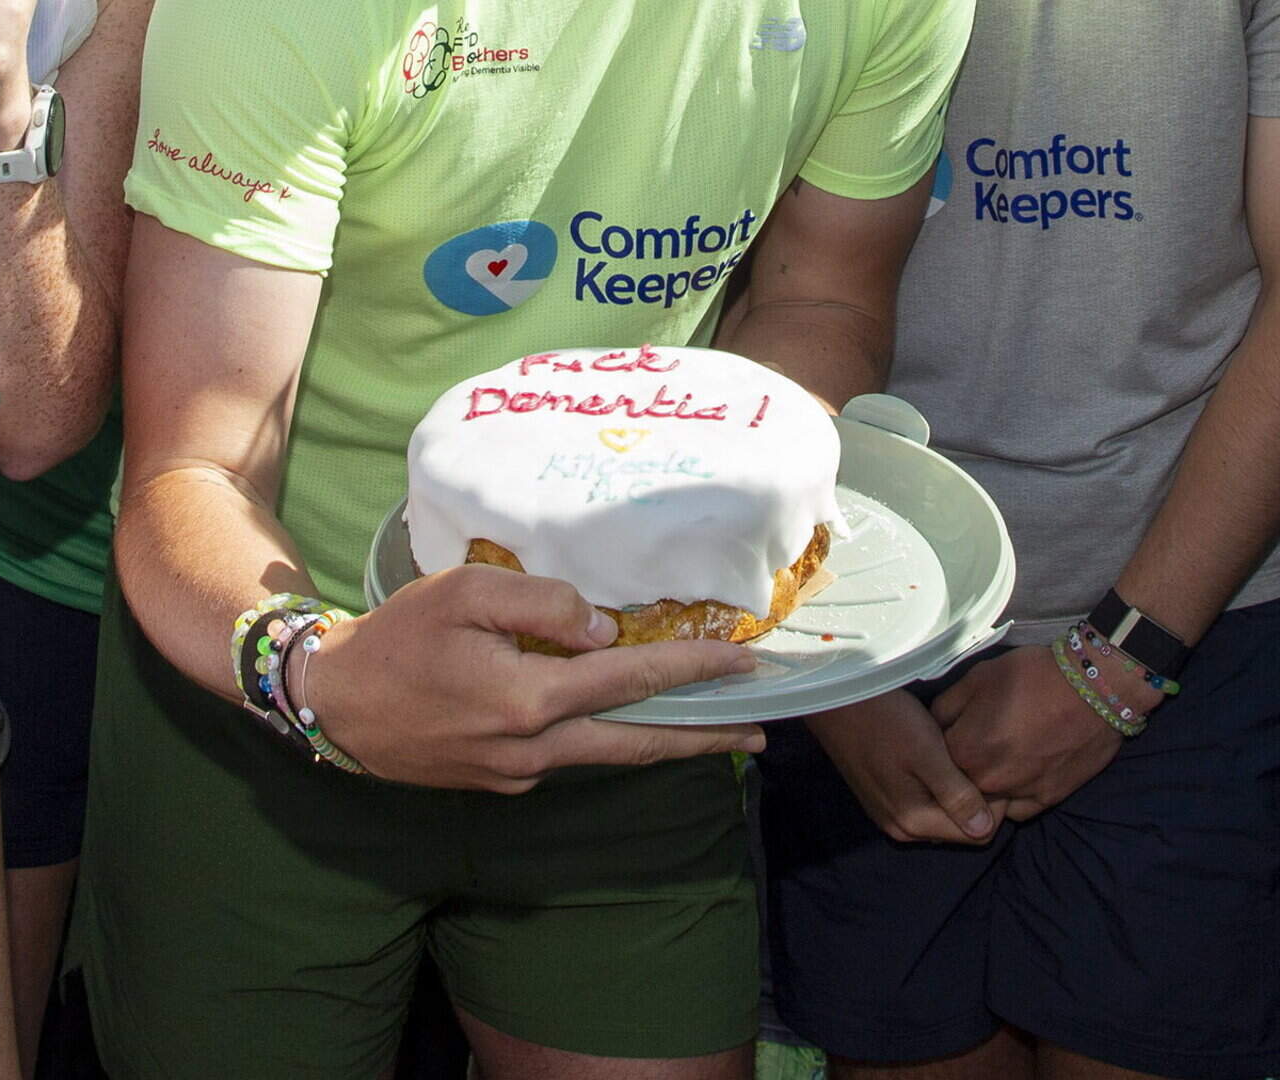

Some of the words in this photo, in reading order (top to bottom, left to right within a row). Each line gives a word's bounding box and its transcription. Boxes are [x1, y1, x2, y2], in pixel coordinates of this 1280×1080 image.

[148, 128, 185, 161] Love
[188, 152, 275, 202] always
[966, 134, 1133, 180] Comfort
[570, 209, 757, 259] Comfort
[463, 384, 728, 421] Dementia
[747, 394, 770, 428] !
